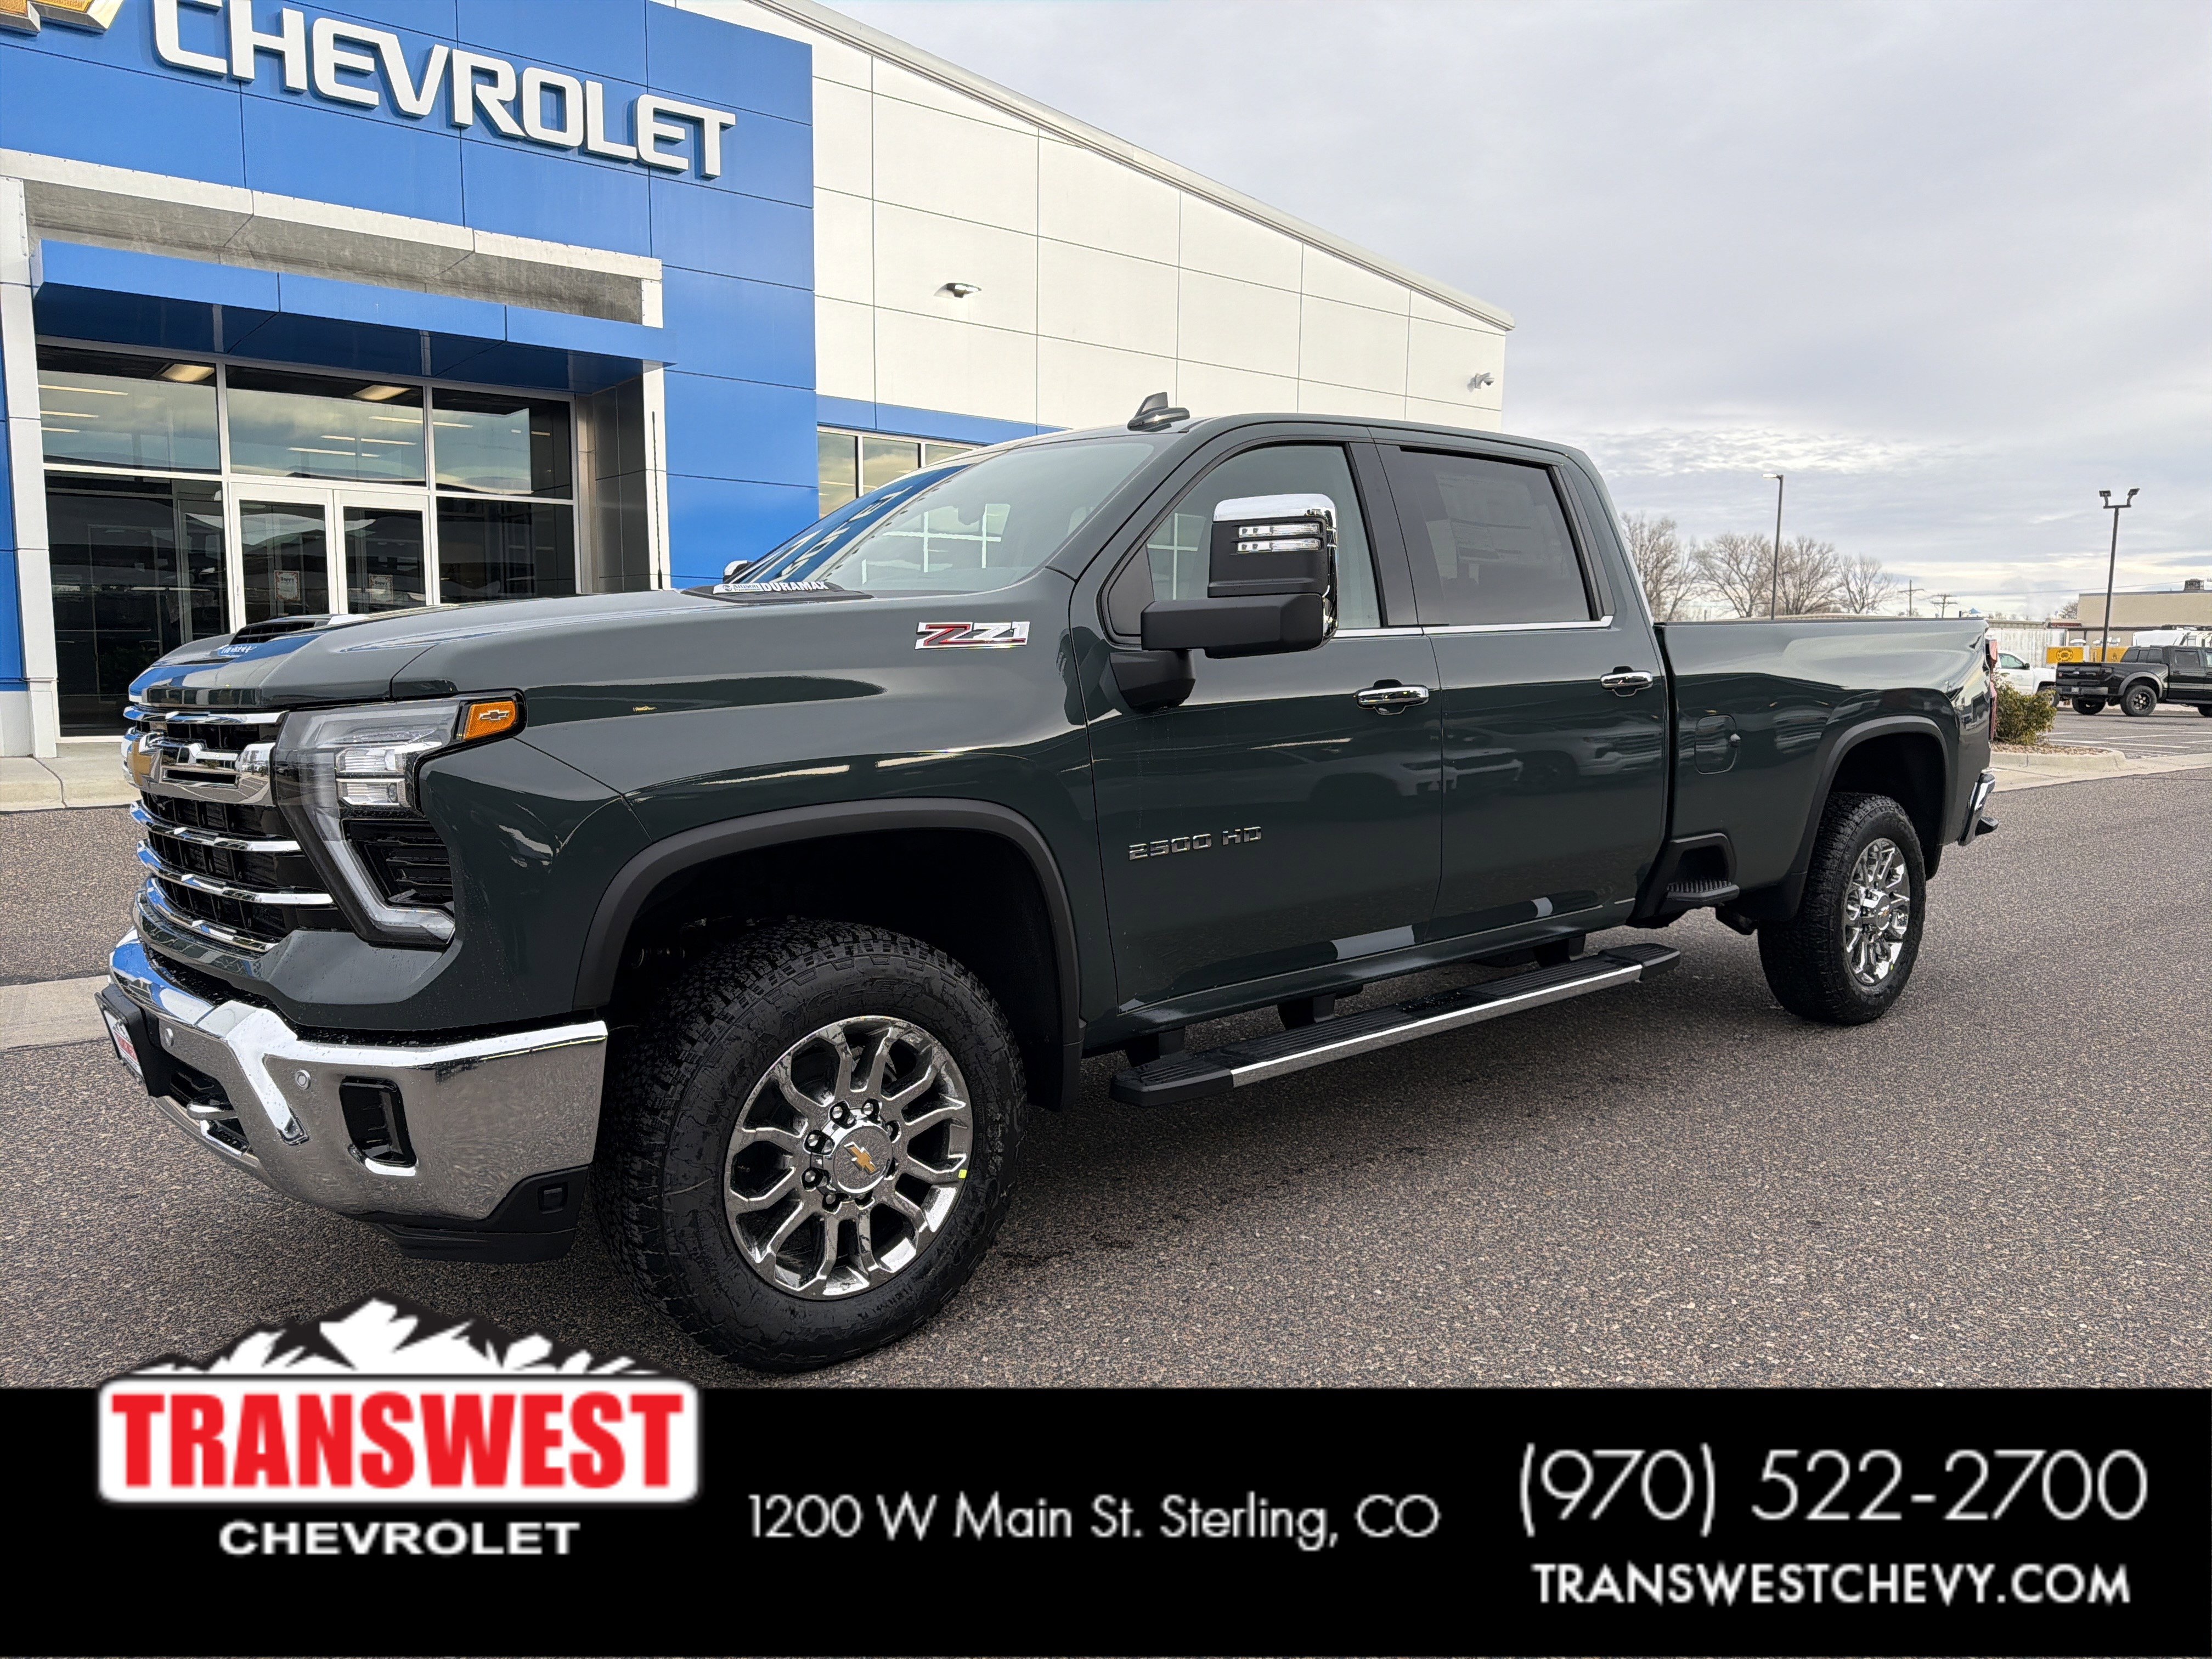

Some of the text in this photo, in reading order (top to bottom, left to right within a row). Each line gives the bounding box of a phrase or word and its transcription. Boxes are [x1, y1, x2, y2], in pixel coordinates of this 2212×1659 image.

[153, 0, 736, 178] CHEVROLET
[760, 581, 829, 591] DURAMAX
[915, 622, 1030, 650] Z71
[1128, 826, 1262, 860] 2500 HD
